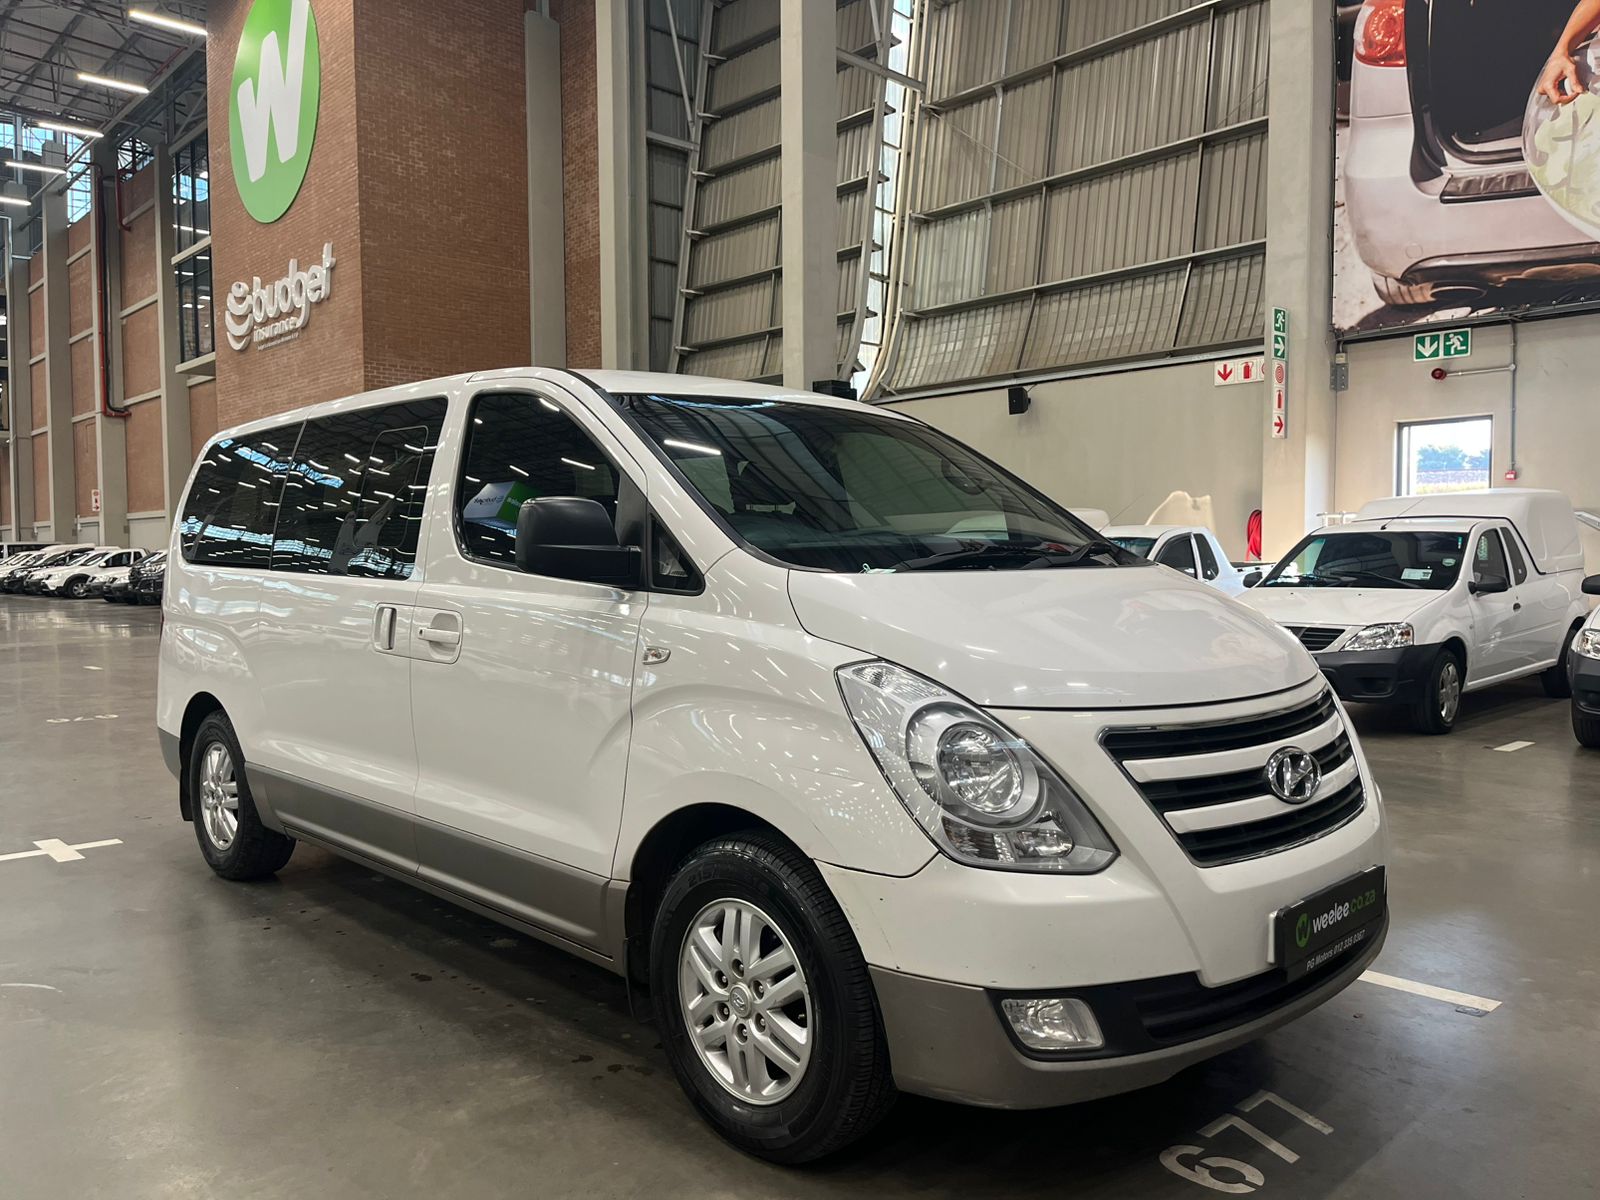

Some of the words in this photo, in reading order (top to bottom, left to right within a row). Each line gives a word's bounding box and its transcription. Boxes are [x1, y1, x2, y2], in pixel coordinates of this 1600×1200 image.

[252, 242, 336, 328] budget
[253, 316, 301, 342] insurance
[1159, 1089, 1335, 1193] 677
